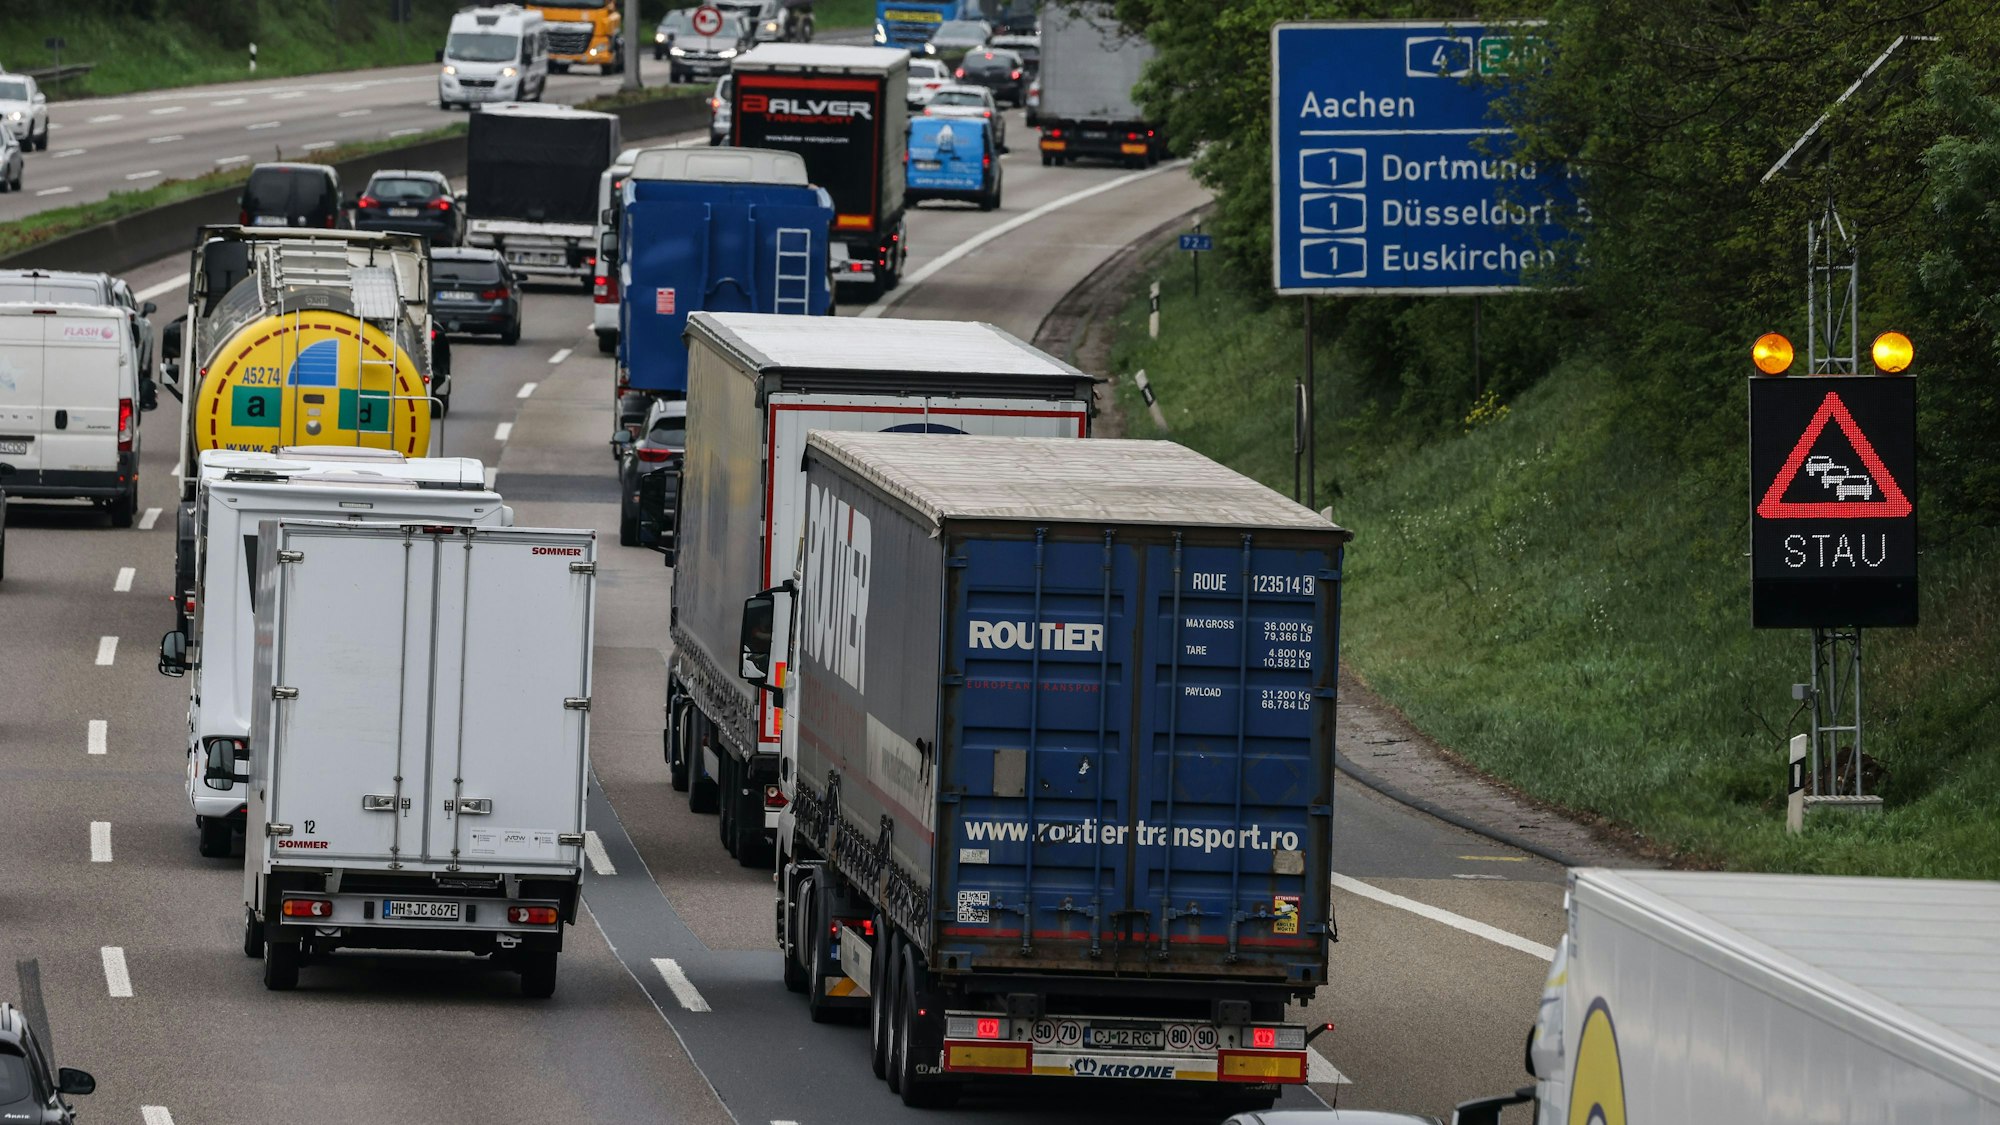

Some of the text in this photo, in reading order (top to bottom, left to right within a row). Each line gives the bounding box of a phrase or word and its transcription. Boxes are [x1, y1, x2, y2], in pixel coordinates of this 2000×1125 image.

[742, 95, 872, 120] BALVER
[1300, 91, 1415, 118] Aachen
[1328, 157, 1337, 180] 1
[1383, 154, 1536, 181] Dortmund
[1329, 202, 1338, 225] 1
[1383, 199, 1554, 226] Düsseldorf
[1329, 246, 1338, 270] 1
[1383, 243, 1555, 270] Euskirchen
[64, 327, 99, 336] FLASH
[247, 395, 265, 417] a
[359, 403, 372, 423] d
[532, 547, 581, 556] SOMMER
[1784, 534, 1887, 567] STAU
[1193, 573, 1227, 591] ROUE
[1186, 619, 1313, 634] MAX GROSS 36.000 Kg
[1264, 632, 1312, 642] 79,366 Lb
[1186, 645, 1312, 660] TARE 4.800 Kg
[1263, 658, 1310, 668] 10,582 Lb
[967, 680, 1030, 690] EUROPEAN
[1185, 687, 1311, 702] PAYLOAD 31.200 Kg
[1262, 700, 1309, 710] 68,784 Lb
[304, 820, 315, 834] 12
[278, 840, 328, 849] SOMMER
[391, 903, 457, 917] HH JC 867E
[1035, 1025, 1213, 1045] 50 70 CJ 12 RCT 80 90
[1098, 1063, 1175, 1079] KRONE
